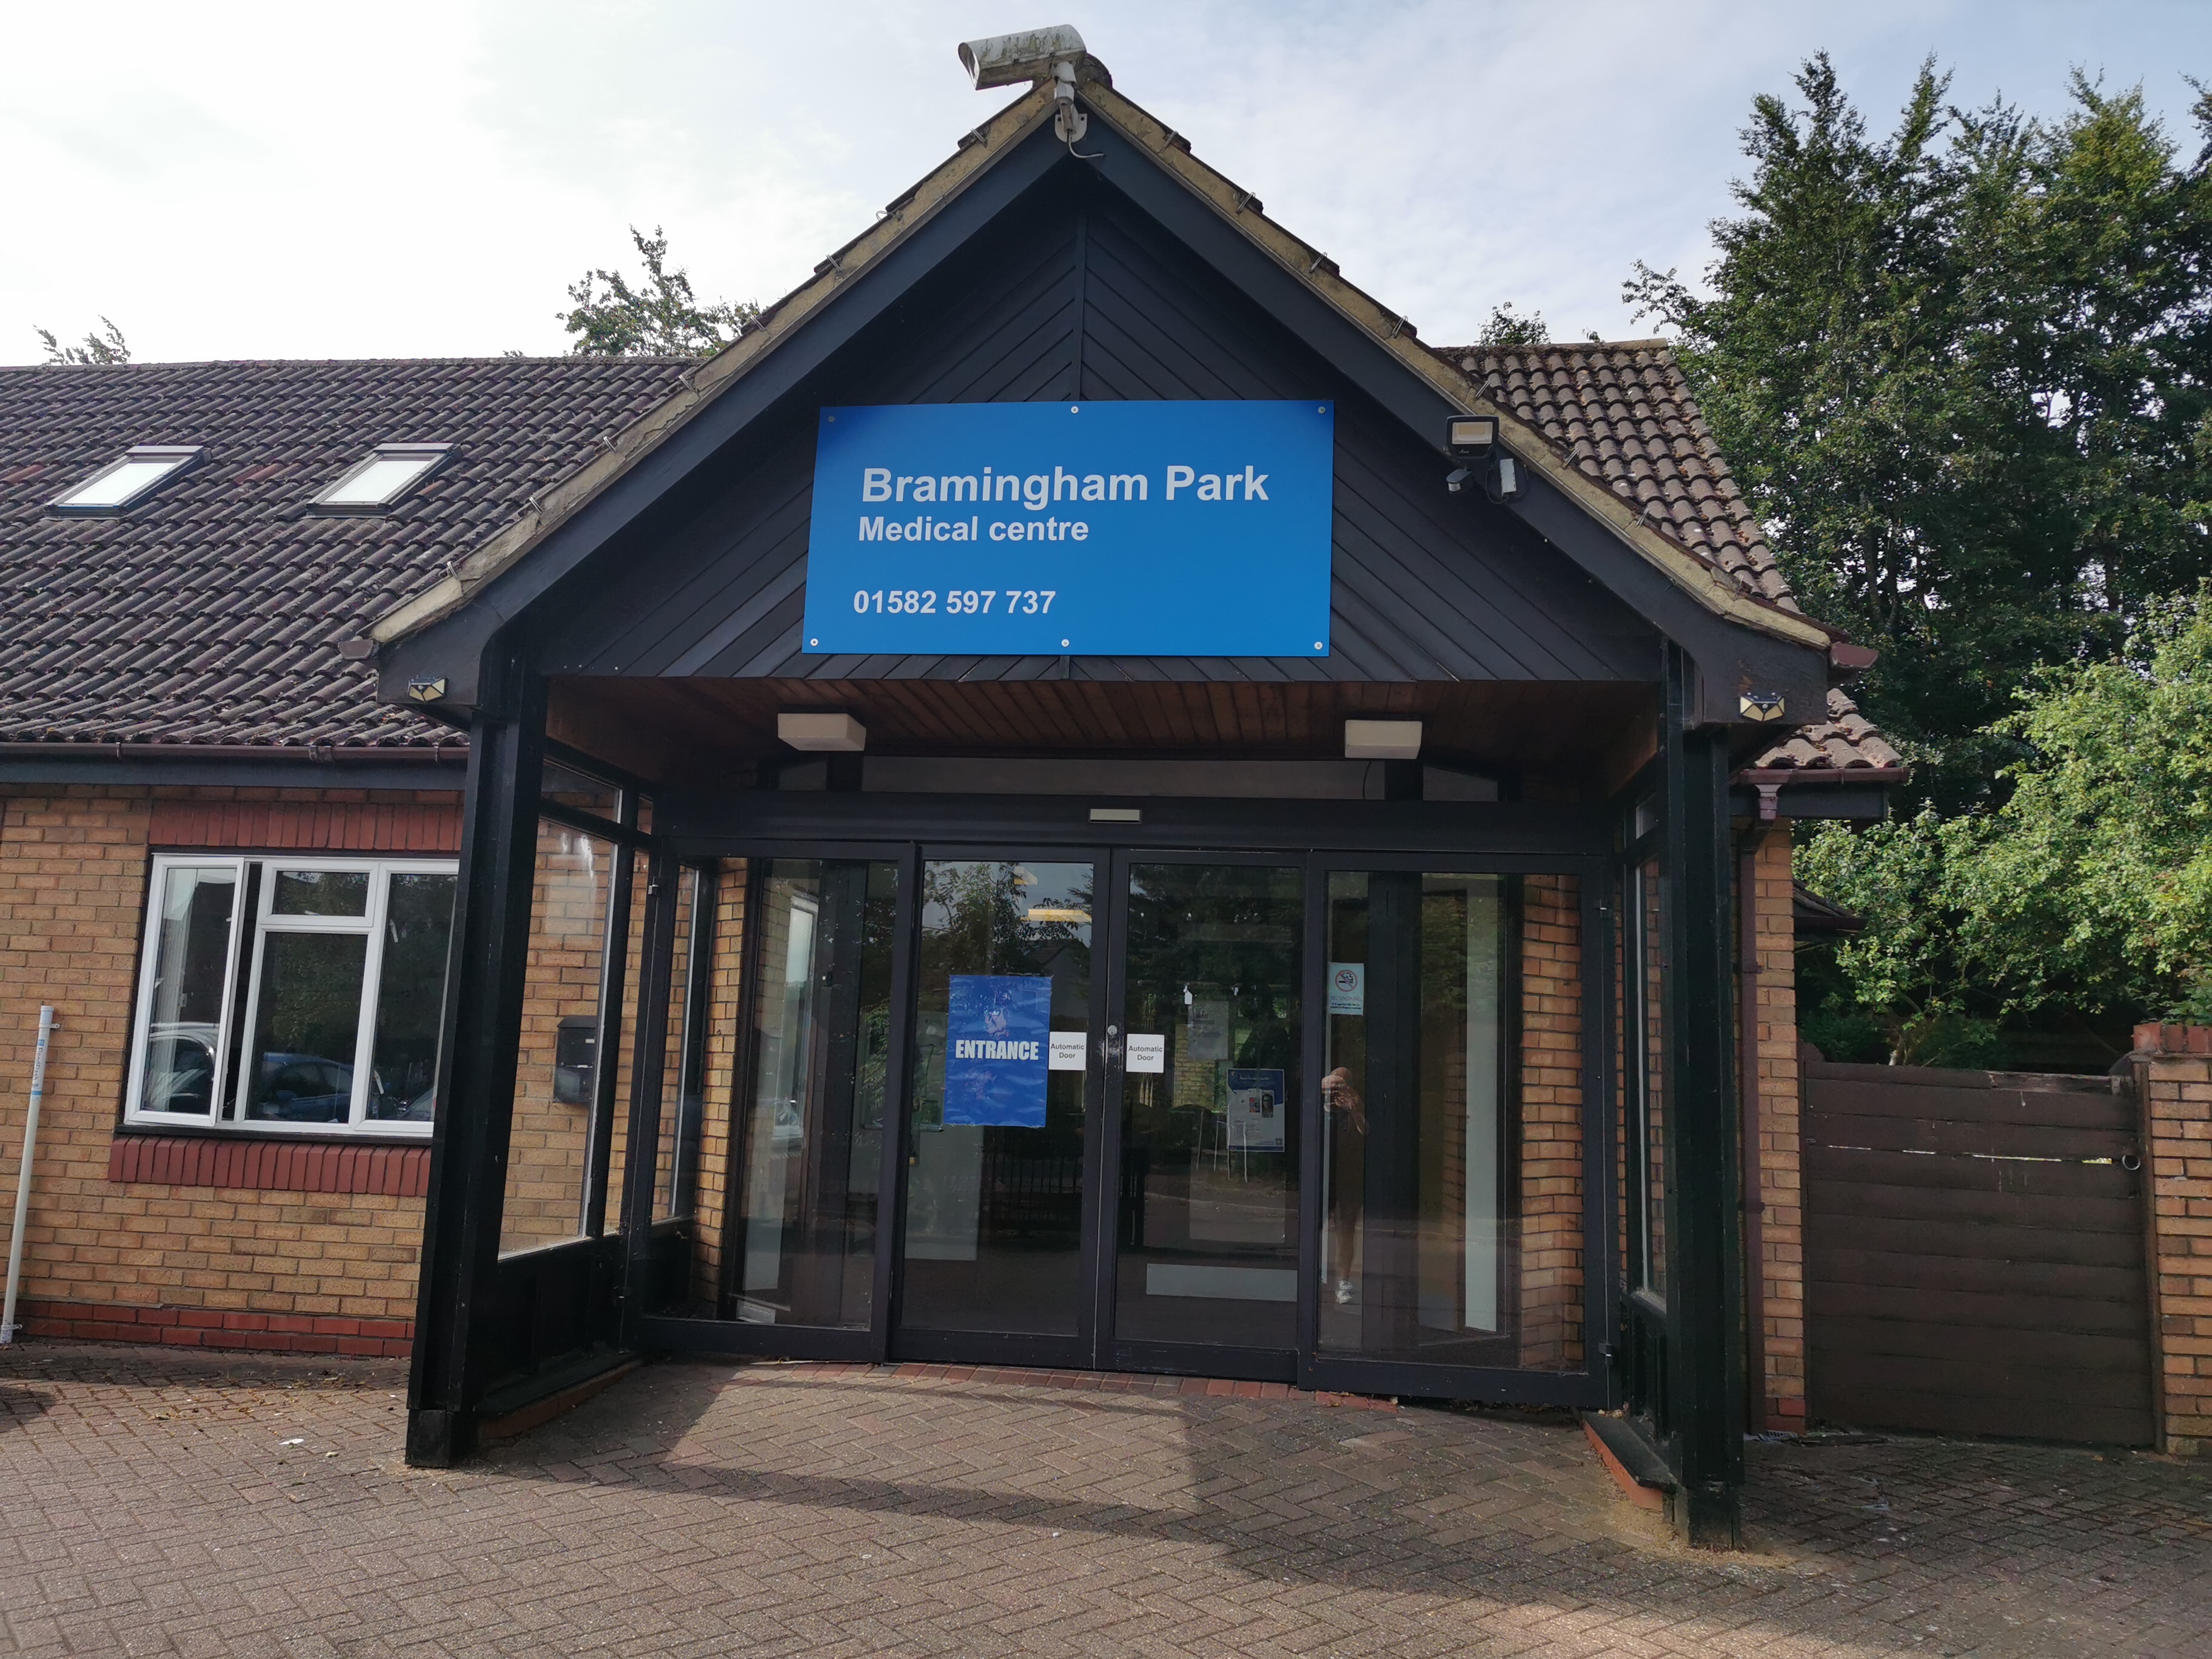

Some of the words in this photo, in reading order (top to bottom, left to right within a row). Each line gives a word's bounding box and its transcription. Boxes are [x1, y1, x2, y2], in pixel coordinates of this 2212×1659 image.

[862, 466, 1148, 511] Bramingham
[1165, 464, 1270, 501] Park
[858, 515, 978, 541] Medical
[988, 516, 1090, 541] centre
[853, 590, 937, 614] 01582
[946, 590, 996, 614] 597
[1006, 590, 1056, 614] 737
[955, 1039, 1039, 1061] ENTRANCE
[33, 1047, 43, 1081] FloodFlash
